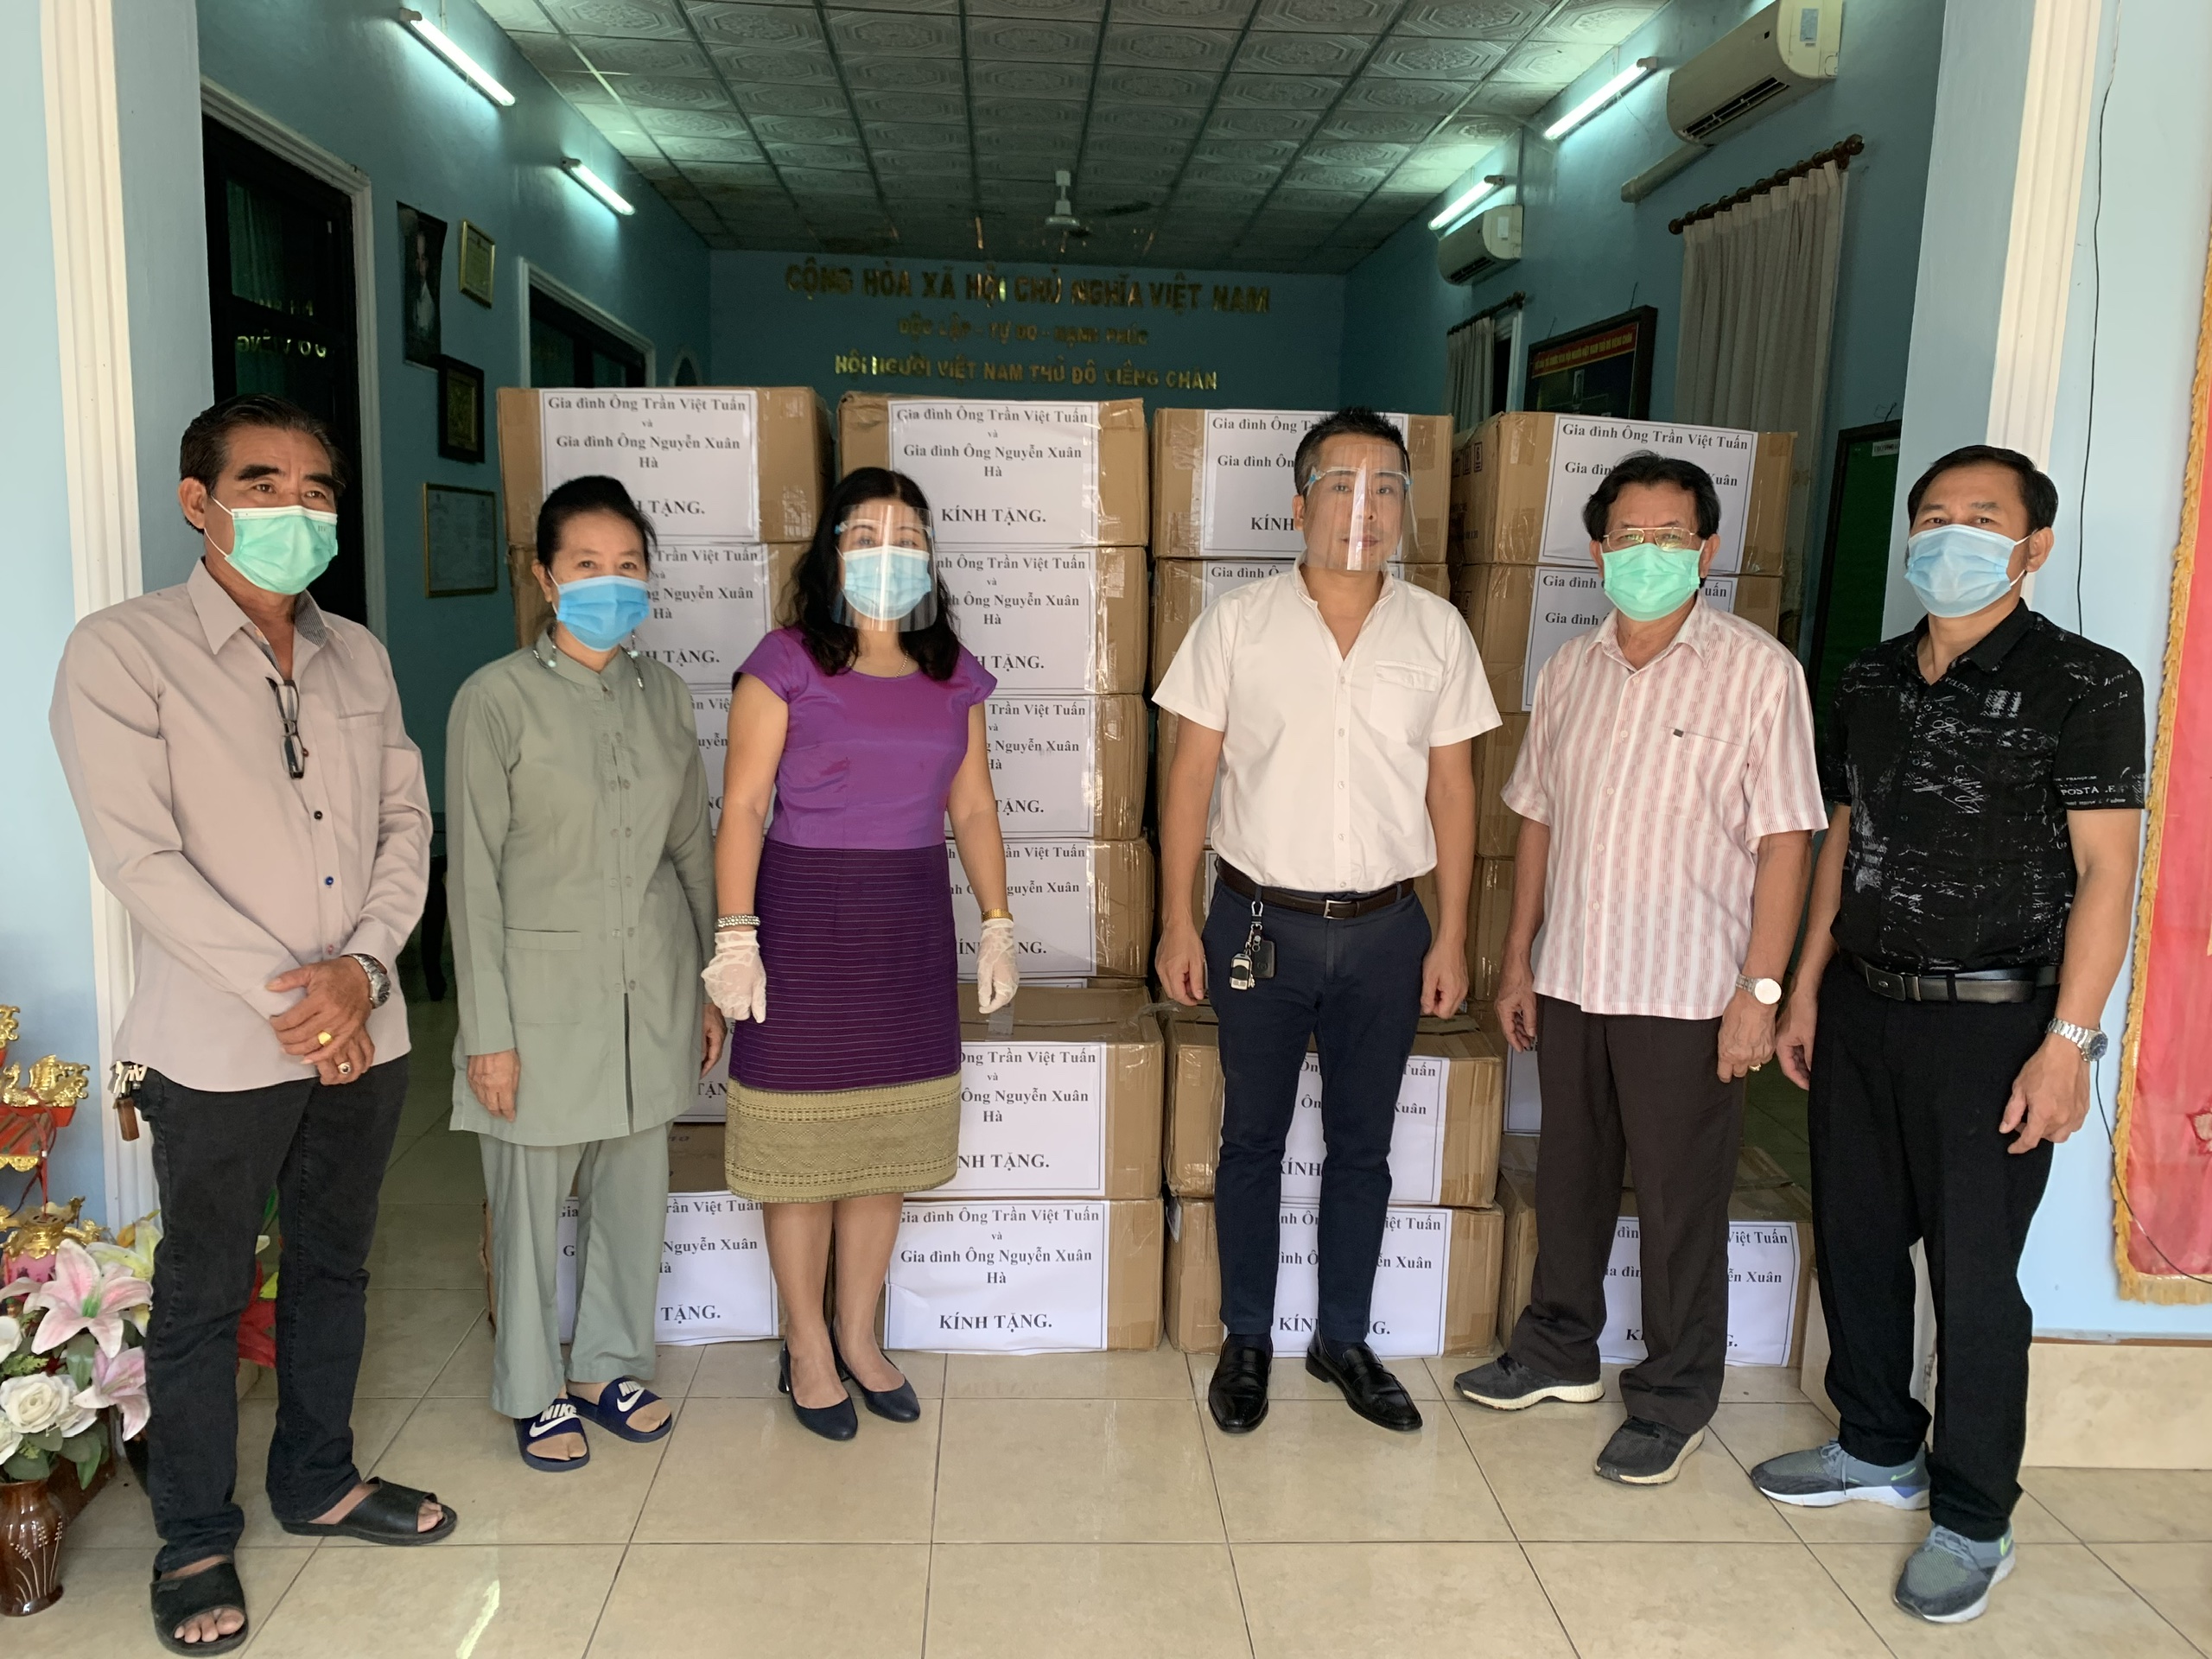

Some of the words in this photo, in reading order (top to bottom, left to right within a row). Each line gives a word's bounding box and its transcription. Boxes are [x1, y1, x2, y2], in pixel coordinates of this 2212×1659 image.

[785, 257, 853, 300] CỘNG
[864, 261, 911, 297] HÒA
[921, 265, 956, 301] XÃ
[965, 266, 1007, 308] HỘI
[1014, 267, 1062, 303] CHỦ
[1071, 273, 1142, 308] NGHĨA
[1149, 272, 1202, 315] VIỆT
[1213, 286, 1269, 313] NAM
[835, 349, 866, 382] HỘI
[938, 354, 977, 381] VIỆT
[983, 362, 1023, 382] NAM
[1029, 354, 1066, 383] THỦ
[1071, 359, 1096, 385] ĐÔ
[549, 397, 572, 409] Gia
[576, 397, 605, 410] đình
[610, 395, 638, 411] Ông
[642, 392, 675, 410] Trần
[681, 398, 707, 413] Việt
[711, 393, 746, 411] Tuấn
[897, 410, 923, 422] Gia
[925, 409, 952, 421] đình
[957, 405, 984, 423] Ông
[987, 406, 1020, 422] Trần
[1024, 410, 1050, 425] Việt
[1054, 407, 1088, 423] Tuấn
[641, 419, 653, 428] và
[1212, 417, 1236, 429] Gia
[1239, 417, 1268, 430] đình
[1271, 416, 1297, 433] Ông
[556, 435, 580, 448] Gia
[584, 435, 613, 448] đình
[618, 434, 646, 450] Ông
[650, 434, 701, 451] Nguyễn
[705, 438, 740, 449] Xuân
[1562, 423, 1585, 436] Gia
[1589, 425, 1618, 439] đình
[1622, 425, 1648, 443] Ông
[1653, 429, 1683, 444] Trần
[1688, 434, 1713, 449] Việt
[1717, 432, 1748, 450] Tuấn
[904, 445, 926, 456] Gia
[931, 444, 959, 457] đình
[963, 443, 991, 460] Ông
[995, 444, 1043, 461] Nguyễn
[1047, 448, 1082, 459] Xuân
[639, 456, 658, 468] Hà
[1217, 454, 1240, 467] Gia
[1244, 454, 1272, 467] đình
[1276, 453, 1294, 468] Ôn
[1565, 461, 1587, 475] Gia
[1592, 463, 1613, 476] đìn
[984, 466, 1001, 477] Hà
[649, 499, 705, 515] TẶNG.
[942, 505, 987, 522] KÍNH
[992, 507, 1046, 525] TẶNG.
[1251, 515, 1294, 531] KÍNH
[657, 543, 687, 562] Trần
[693, 550, 720, 564] Việt
[724, 545, 758, 562] Tuấn
[938, 557, 952, 569] nh
[957, 554, 983, 571] Ông
[987, 554, 1019, 569] Trần
[1024, 558, 1048, 571] Việt
[1052, 555, 1085, 569] Tuấn
[1211, 567, 1233, 578] Gia
[1237, 567, 1264, 579] đình
[987, 577, 997, 586] và
[1543, 575, 1566, 588] Gia
[1569, 575, 1597, 589] đình
[1705, 581, 1727, 597] uấn
[664, 585, 714, 602] Nguyễn
[718, 588, 753, 599] Xuân
[963, 592, 990, 607] Ông
[995, 591, 1041, 608] Nguyễn
[1046, 595, 1079, 606] Xuân
[653, 607, 672, 620] Hà
[983, 613, 1001, 625] Hà
[1545, 612, 1567, 625] Gia
[1571, 613, 1599, 626] đình
[663, 649, 719, 666] TẶNG.
[992, 655, 1044, 672] TẶNG.
[709, 698, 730, 712] Việ
[989, 701, 1020, 715] Trần
[1024, 704, 1049, 717] Việt
[1052, 701, 1085, 715] Tuấn
[988, 722, 998, 732] và
[995, 738, 1042, 754] Nguyễn
[1046, 741, 1079, 752] Xuân
[2061, 786, 2099, 796] POSTA
[1024, 847, 1049, 860] Việt
[1052, 844, 1085, 858] Tuấn
[1007, 880, 1042, 897] guyễn
[1047, 881, 1079, 893] Xuân
[1019, 941, 1046, 955] NG.
[988, 1047, 1022, 1064] Trần
[1027, 1052, 1055, 1066] Việt
[1059, 1046, 1096, 1064] Tuấn
[988, 1072, 998, 1081] và
[961, 1087, 990, 1106] Ông
[995, 1087, 1047, 1104] Nguyễn
[1052, 1089, 1089, 1102] Xuân
[1301, 1094, 1321, 1109] Ôn
[983, 1109, 1003, 1122] Hà
[958, 1154, 985, 1168] NH
[990, 1152, 1049, 1172] TẶNG.
[667, 1198, 689, 1213] rần
[693, 1201, 721, 1215] Việt
[924, 1210, 954, 1223] đình
[959, 1206, 988, 1225] Ông
[992, 1205, 1027, 1223] Trần
[1032, 1210, 1059, 1224] Việt
[1064, 1205, 1099, 1222] Tuấn
[1385, 1217, 1401, 1231] iệt
[1406, 1215, 1440, 1230] Tuấn
[991, 1232, 1003, 1241] và
[1618, 1226, 1638, 1238] đìn
[1754, 1229, 1788, 1243] Tuấn
[664, 1237, 715, 1255] Nguyễn
[720, 1239, 758, 1250] Xuân
[901, 1250, 926, 1263] Gia
[930, 1249, 960, 1263] đình
[965, 1247, 995, 1266] Ông
[999, 1246, 1051, 1265] Nguyễn
[1055, 1249, 1092, 1262] Xuân
[1279, 1252, 1302, 1264] ình
[1395, 1256, 1432, 1268] Xuân
[987, 1271, 1007, 1285] Hà
[1622, 1267, 1641, 1277] đìn
[1746, 1272, 1782, 1282] Xuân
[661, 1305, 721, 1324] TẶNG.
[939, 1313, 988, 1330] KÍNH
[994, 1312, 1052, 1332] TẶNG.
[1280, 1314, 1313, 1332] KÍN
[540, 1403, 576, 1422] NIKE
